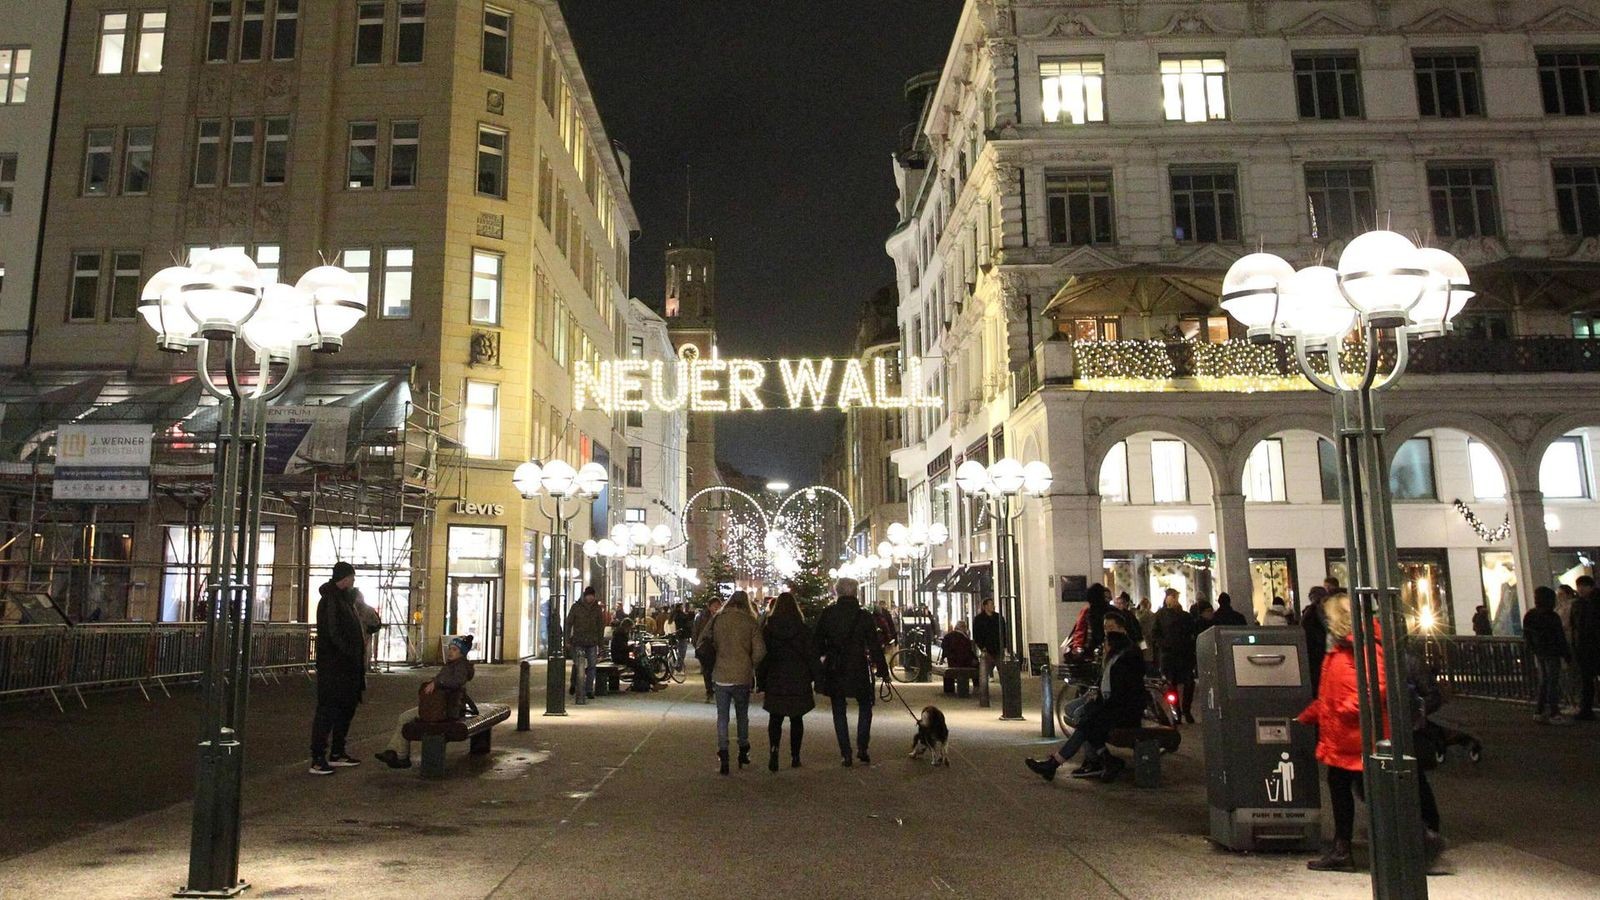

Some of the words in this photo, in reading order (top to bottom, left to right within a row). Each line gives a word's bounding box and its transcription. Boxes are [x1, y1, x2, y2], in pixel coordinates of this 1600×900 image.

[574, 359, 765, 411] NEUER
[778, 357, 944, 411] WALL
[101, 436, 145, 446] WERNER
